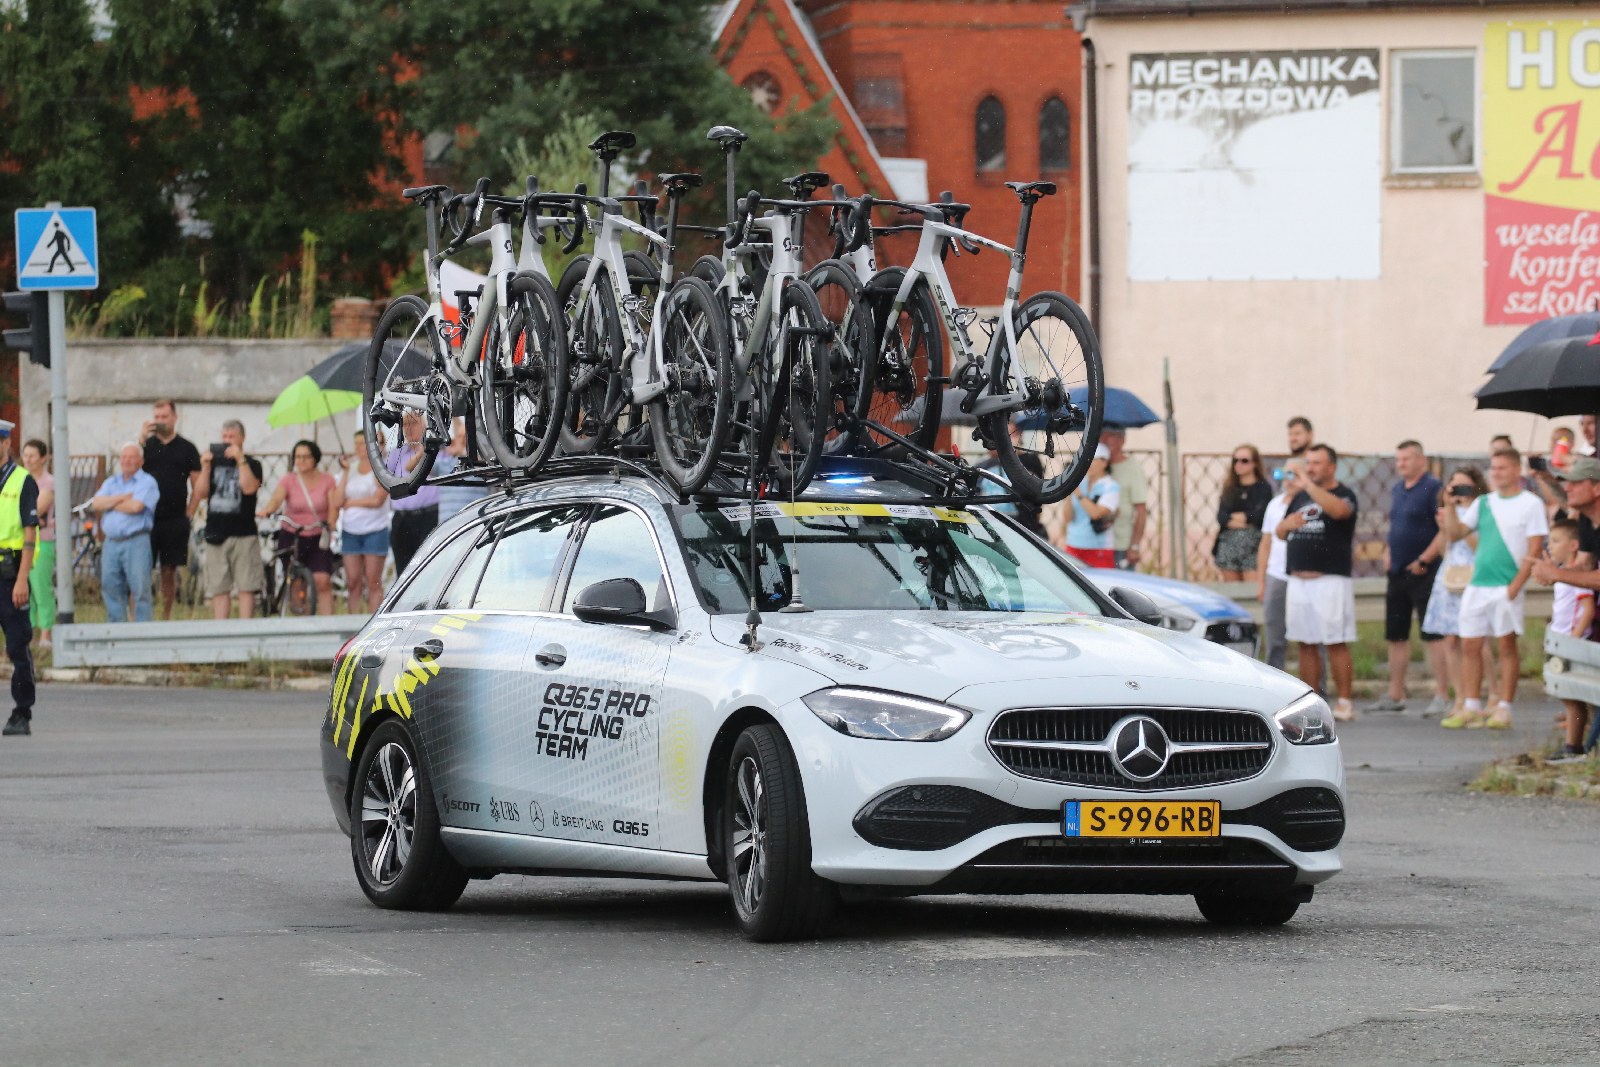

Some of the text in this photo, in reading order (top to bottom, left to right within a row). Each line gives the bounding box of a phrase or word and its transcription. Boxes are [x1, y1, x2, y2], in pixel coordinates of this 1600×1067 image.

[1131, 56, 1378, 85] MECHANIKA
[1498, 100, 1600, 192] A
[1496, 212, 1600, 246] wesela
[1509, 245, 1600, 288] konfe
[770, 638, 869, 671] Racing The Future
[543, 683, 651, 717] Q36.5 PRO
[537, 707, 624, 740] CYCLING
[535, 731, 589, 761] TEAM
[450, 800, 480, 813] SCOTT
[499, 801, 520, 821] UBS
[1090, 806, 1213, 832] S-996-RB
[561, 815, 604, 831] BREITLING
[612, 819, 649, 837] Q36.5
[1067, 822, 1078, 831] NL
